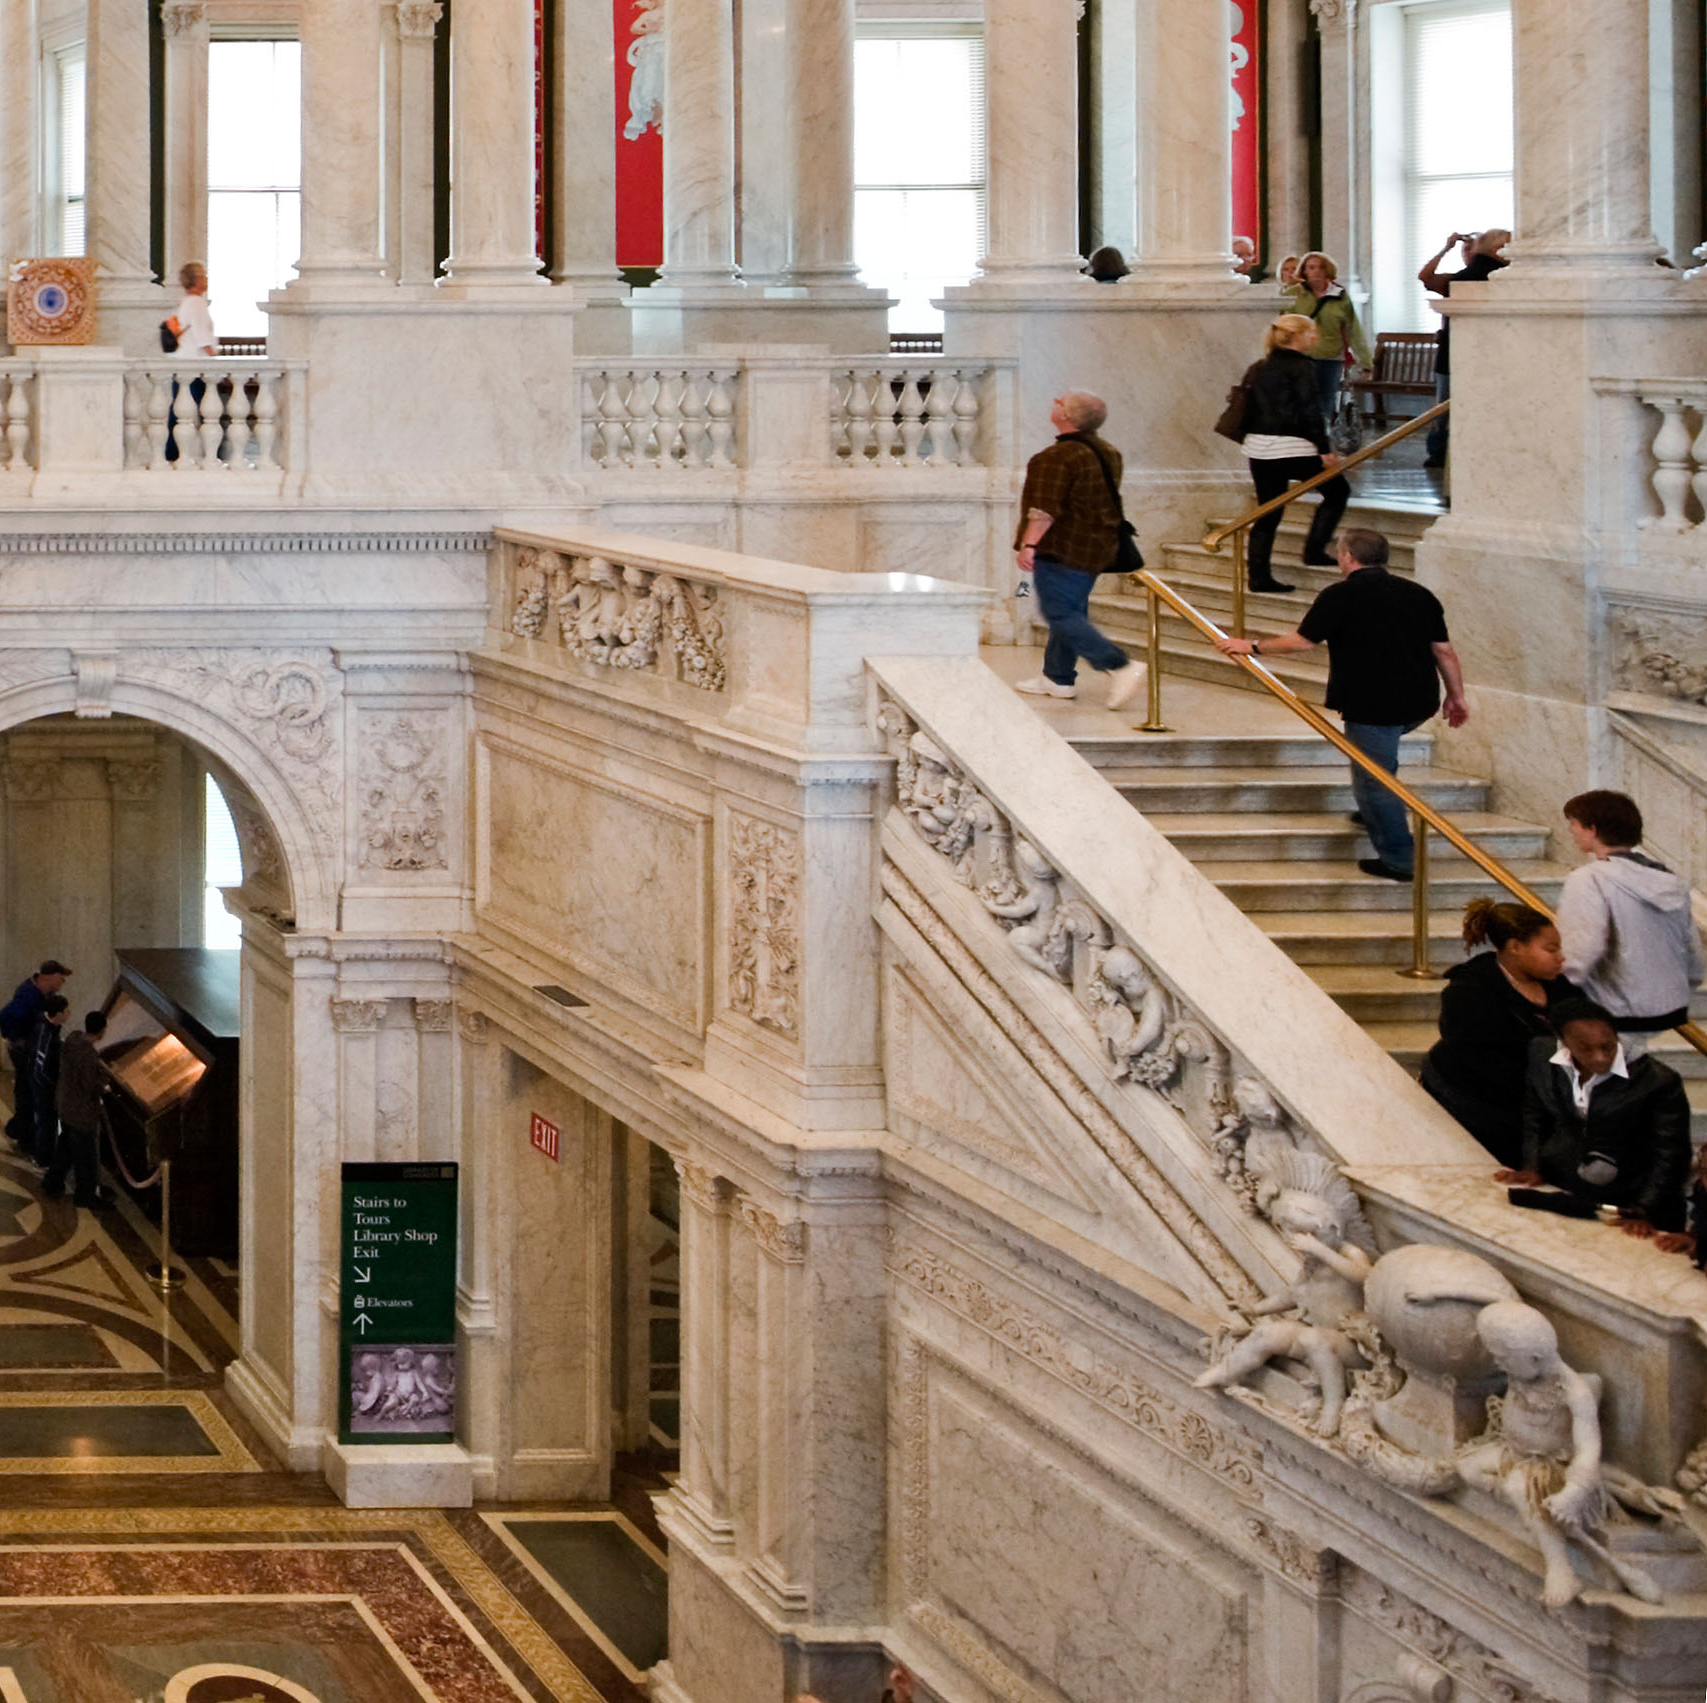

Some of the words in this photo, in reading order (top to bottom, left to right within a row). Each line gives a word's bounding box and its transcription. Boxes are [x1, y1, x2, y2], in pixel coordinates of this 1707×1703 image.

[534, 1118, 558, 1157] EXIT
[353, 1195, 390, 1209] Stairs
[393, 1197, 408, 1209] to
[353, 1212, 392, 1225] Tours
[353, 1229, 401, 1246] Library
[403, 1228, 439, 1246] Shop
[352, 1245, 380, 1259] Exit
[366, 1296, 414, 1308] Elevators
